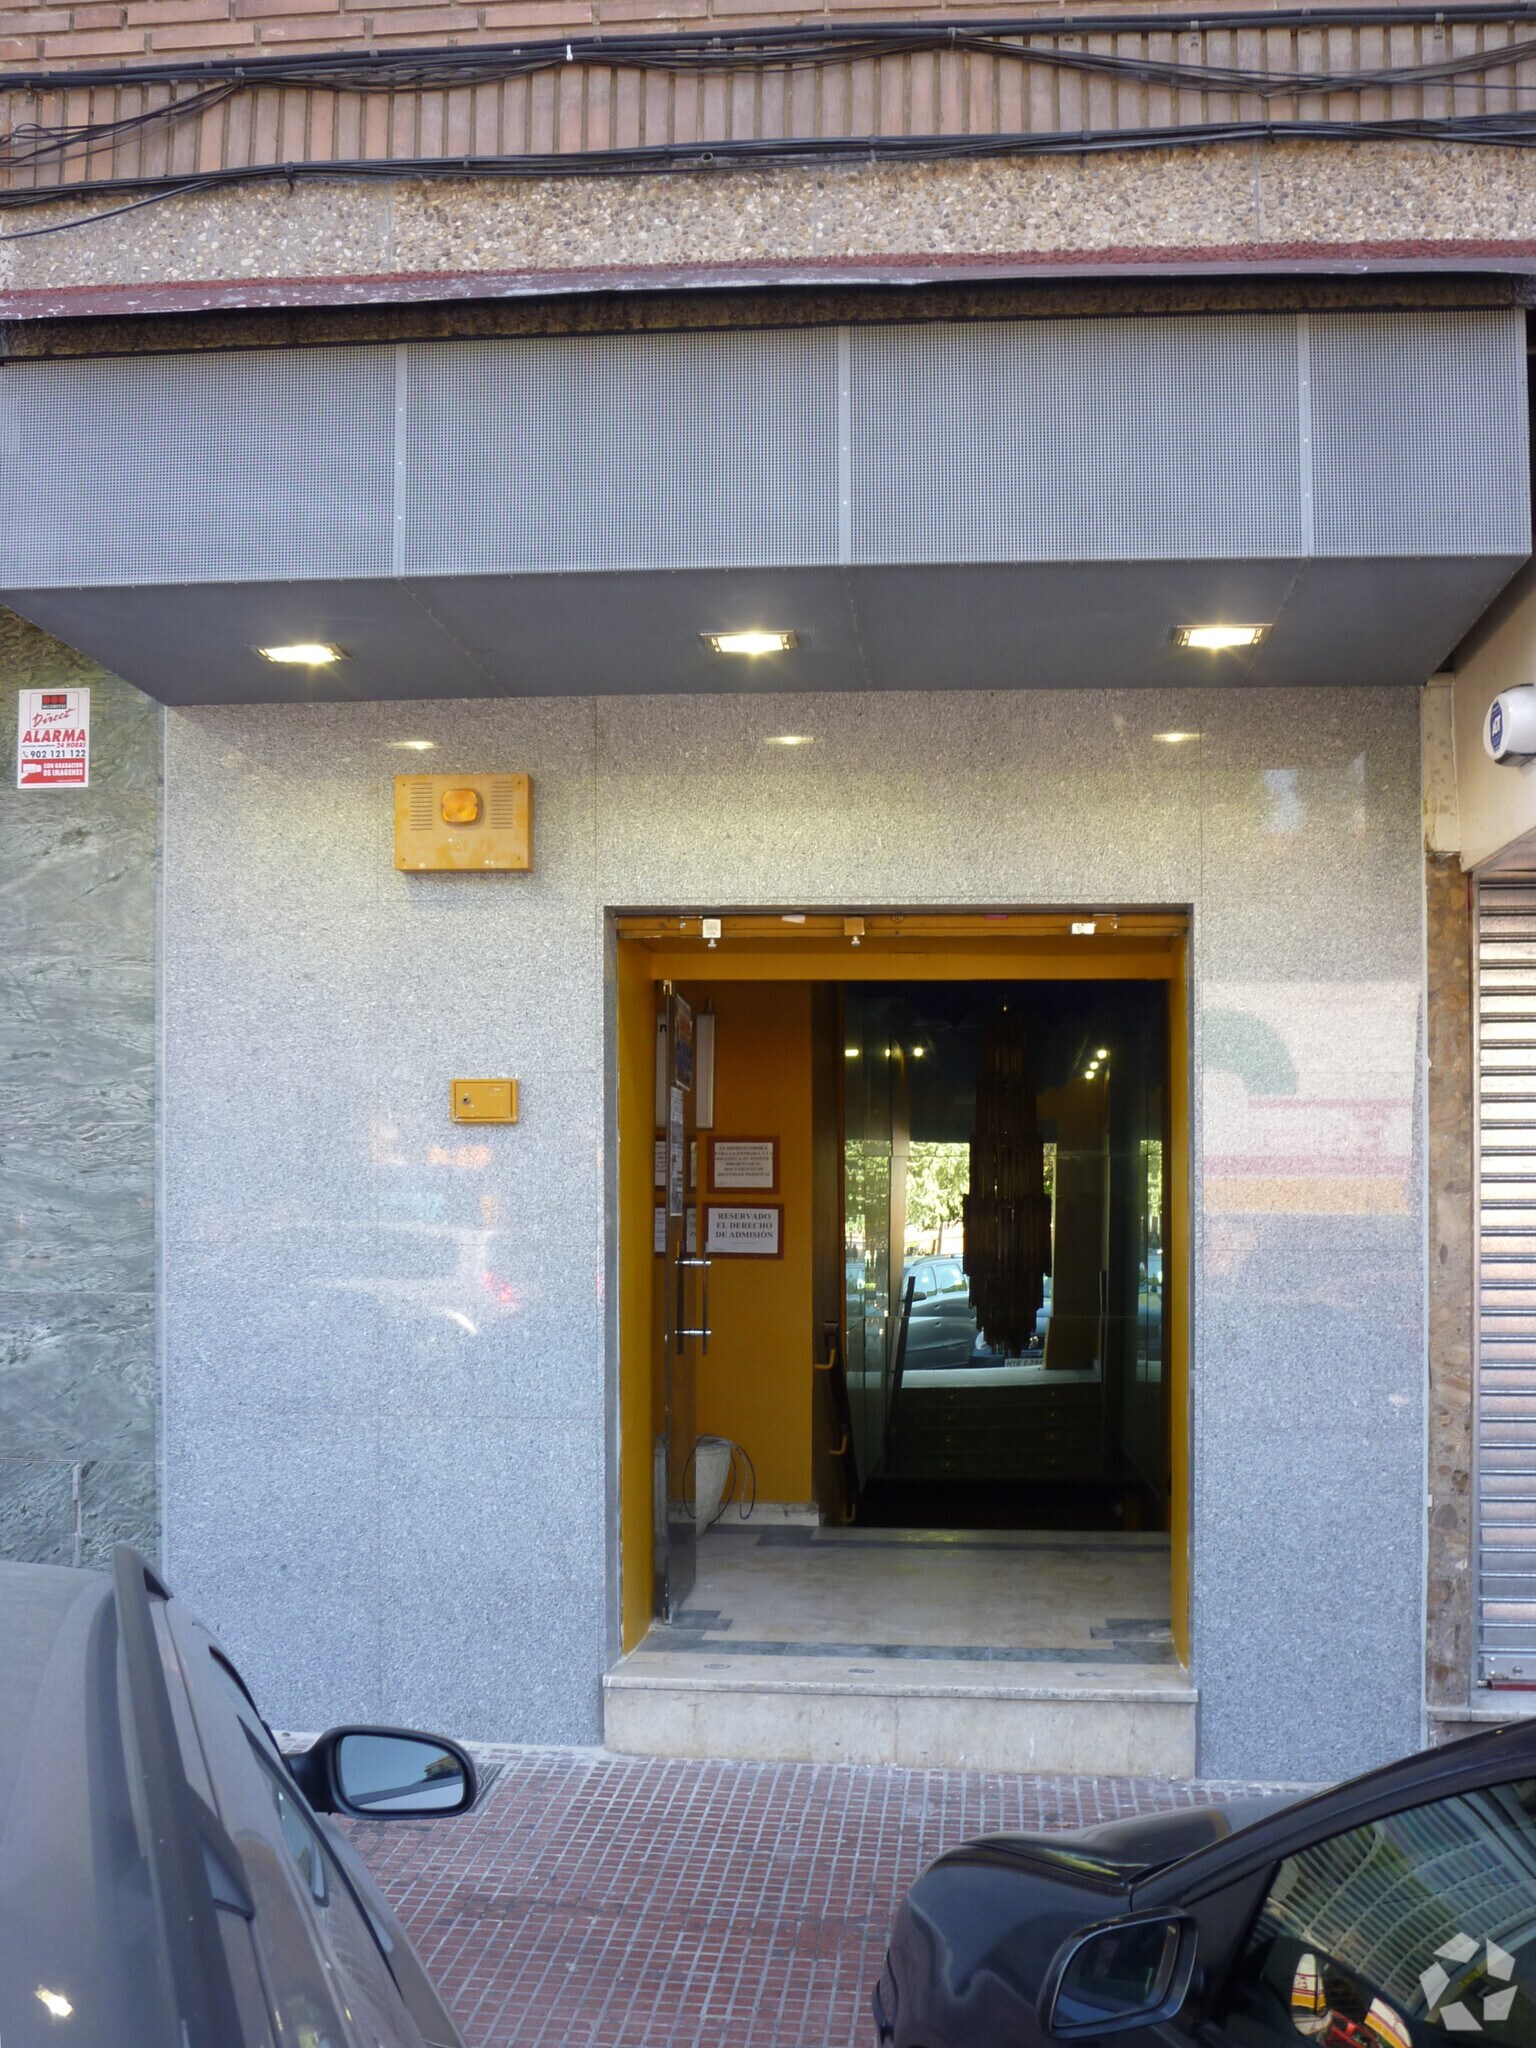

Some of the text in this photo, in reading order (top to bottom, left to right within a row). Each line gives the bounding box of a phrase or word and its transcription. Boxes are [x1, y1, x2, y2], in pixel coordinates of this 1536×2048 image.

[32, 708, 76, 727] Direct
[22, 729, 86, 743] ALARMA
[30, 749, 86, 759] 902 121 122
[43, 768, 83, 777] DE IMAGENES
[718, 1212, 772, 1220] RESERVADO
[729, 1222, 773, 1230] DERECHO
[729, 1230, 773, 1238] ADMISIÓN
